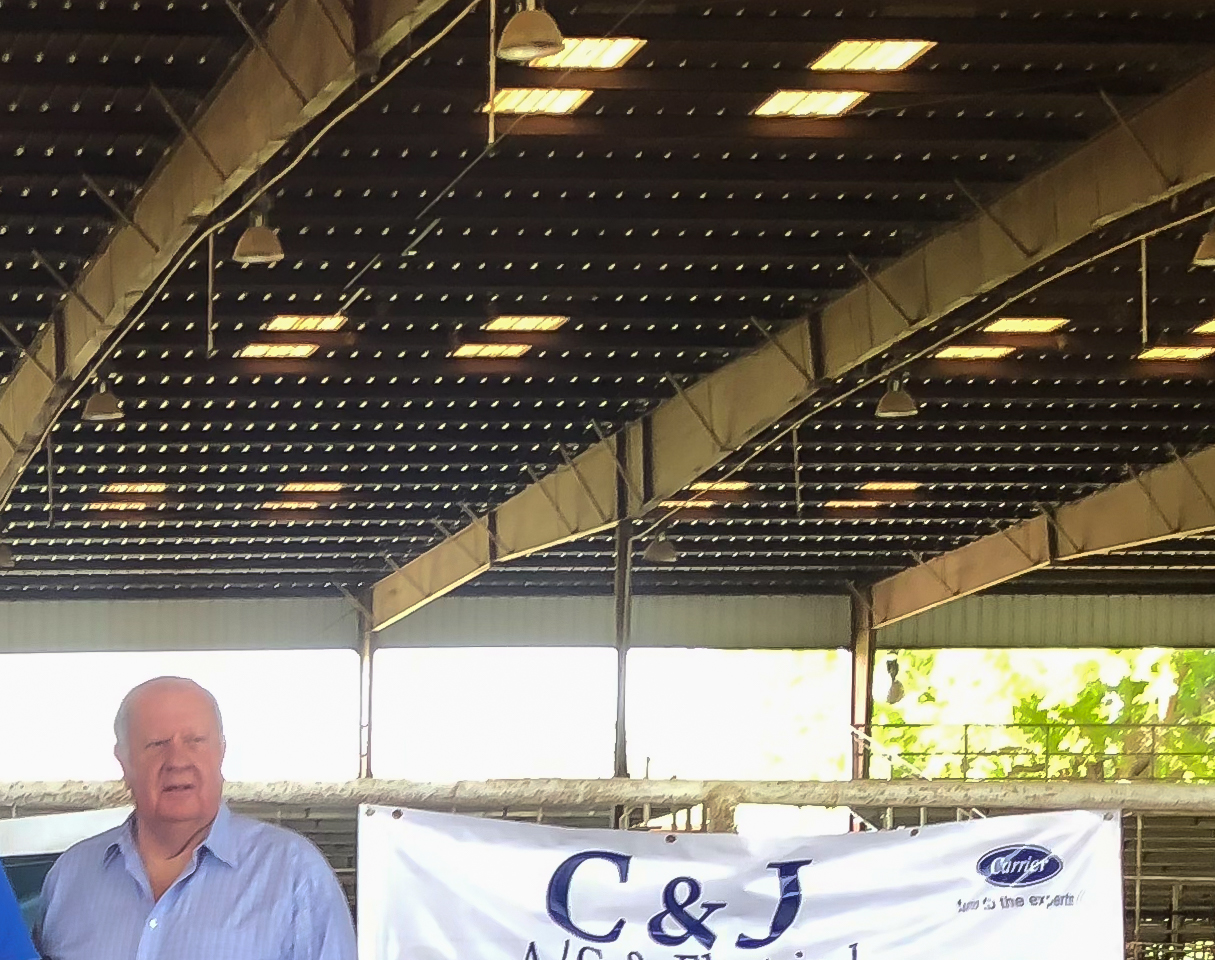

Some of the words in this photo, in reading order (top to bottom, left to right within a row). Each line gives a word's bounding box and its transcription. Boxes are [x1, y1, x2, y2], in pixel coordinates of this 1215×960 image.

[990, 856, 1049, 875] Carrier
[546, 850, 632, 943] C
[647, 876, 727, 950] &
[735, 859, 813, 950] J
